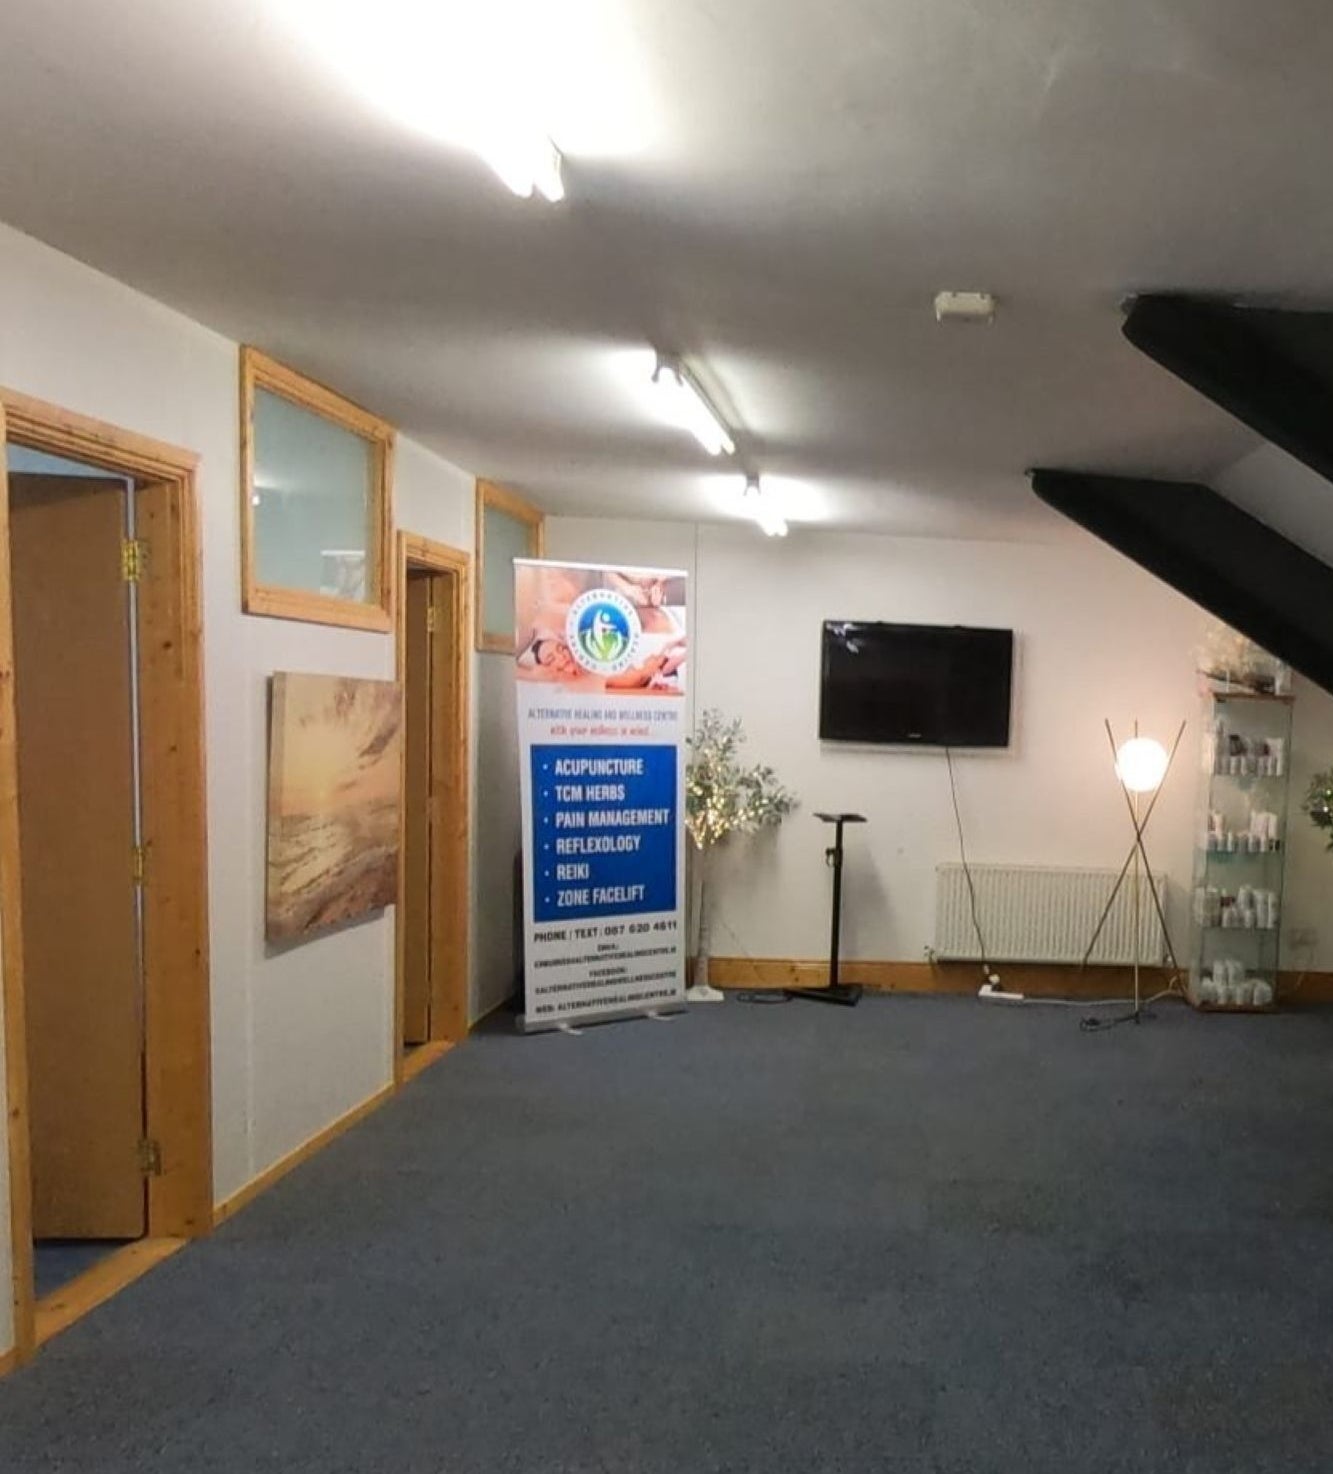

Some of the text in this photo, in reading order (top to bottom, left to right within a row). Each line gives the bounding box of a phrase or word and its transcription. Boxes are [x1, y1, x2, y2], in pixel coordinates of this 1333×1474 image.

[554, 758, 644, 776] ACUPUNCTURE
[555, 784, 626, 802] TCM HERBS
[555, 808, 670, 829] PAIN MANAGEMENT
[556, 835, 641, 855] REFLEXOLOGY
[556, 863, 590, 881] REIKI
[557, 884, 645, 907] ZONE FACELIFT
[534, 931, 567, 942] PHONE
